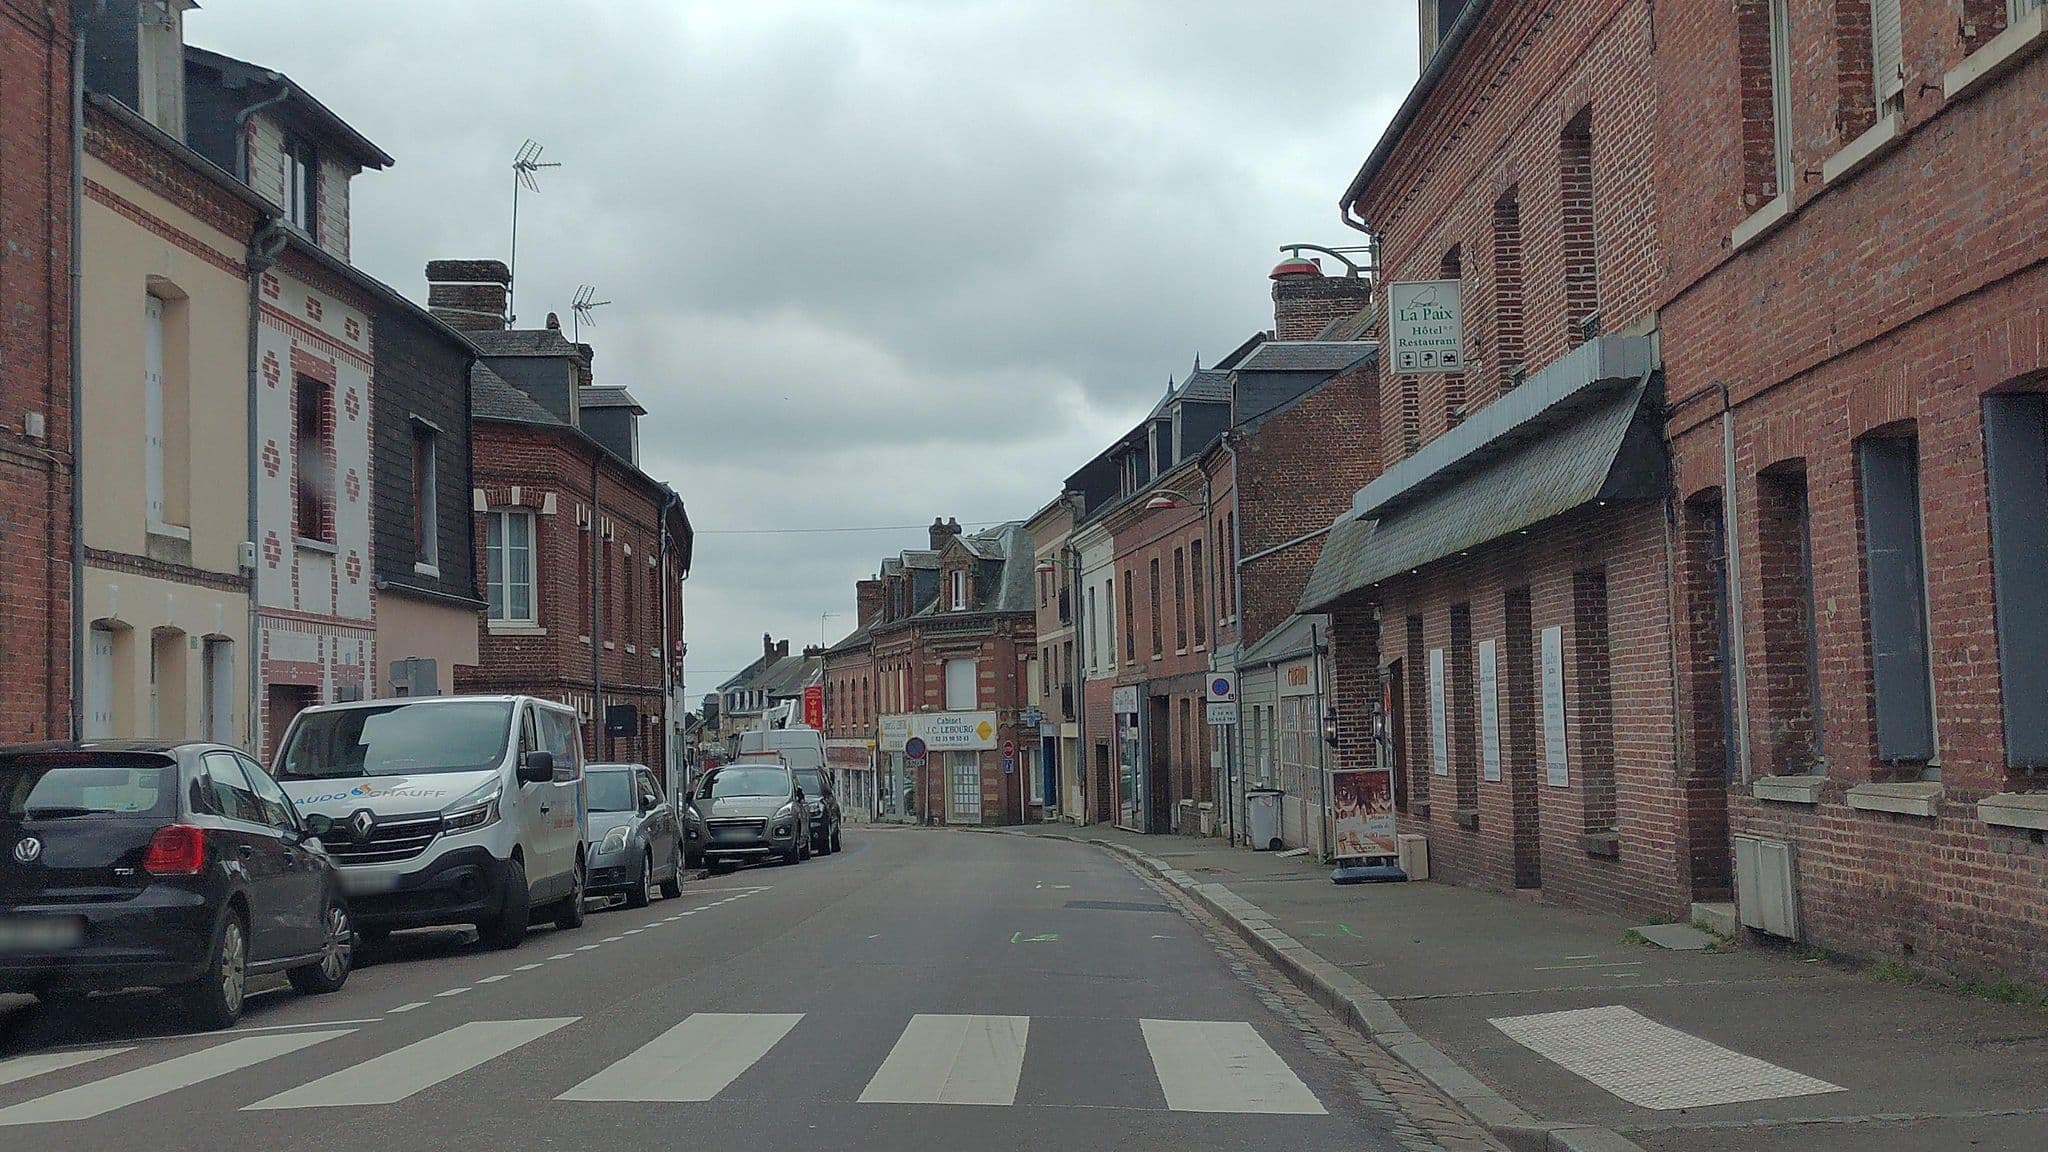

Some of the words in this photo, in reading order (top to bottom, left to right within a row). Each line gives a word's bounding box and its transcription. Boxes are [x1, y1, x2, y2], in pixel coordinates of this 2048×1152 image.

[1400, 309, 1417, 322] La
[1423, 306, 1453, 321] Paix
[1412, 325, 1442, 336] Hôtel
[1399, 337, 1457, 348] Restaurant
[936, 717, 962, 725] Cabinet
[940, 725, 974, 733] LEBOURG
[294, 792, 348, 805] AUDO
[370, 788, 447, 798] CHAUFF
